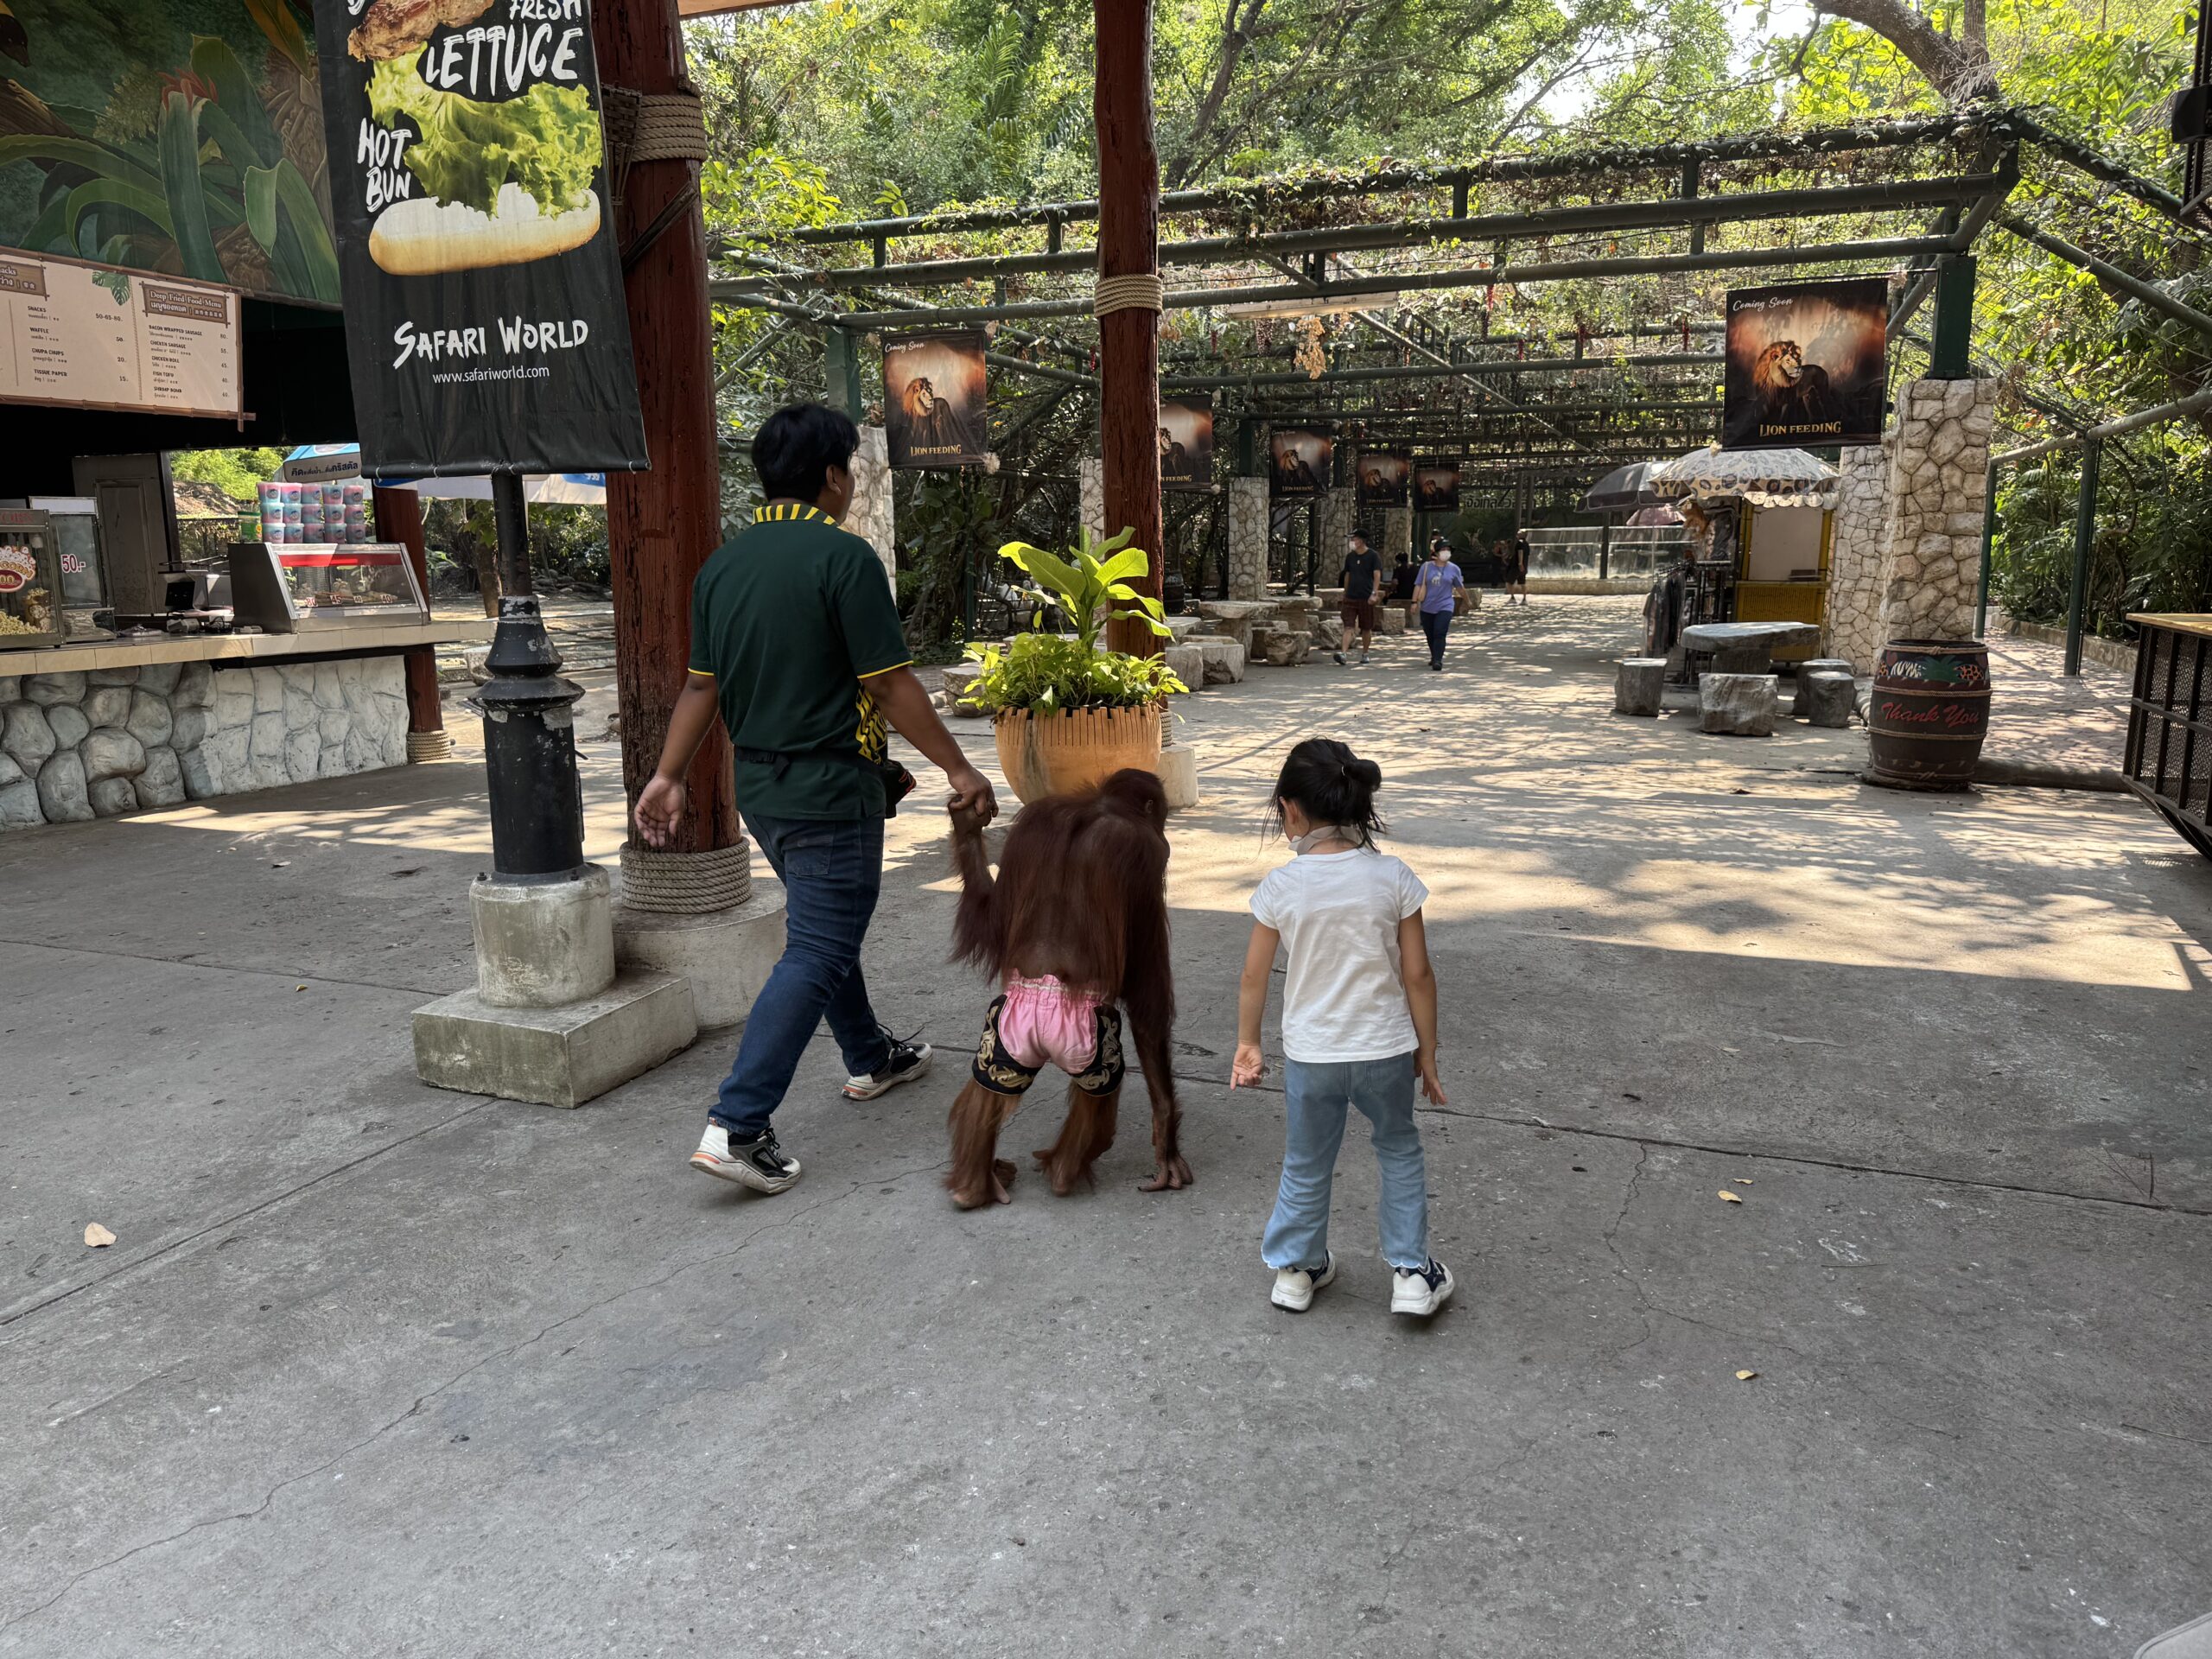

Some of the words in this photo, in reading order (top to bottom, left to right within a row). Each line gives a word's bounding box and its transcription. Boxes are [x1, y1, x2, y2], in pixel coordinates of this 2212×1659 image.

[426, 23, 583, 96] LETTUCE
[357, 118, 412, 169] HOT
[366, 167, 411, 213] BUN
[150, 291, 167, 301] Deep
[169, 294, 185, 302] Fried
[188, 296, 202, 305] Food
[205, 299, 221, 308] Menu
[1732, 300, 1764, 312] Coming
[1769, 296, 1793, 308] Soon
[885, 342, 906, 353] Coming
[908, 340, 925, 351] Soon
[433, 365, 550, 384] www.safariworld.com
[1759, 423, 1786, 437] LION
[1789, 421, 1841, 433] FEEDING
[910, 446, 927, 457] LION
[928, 444, 962, 454] FEEDING
[1881, 702, 1940, 722] Thank
[1943, 704, 1980, 728] You
